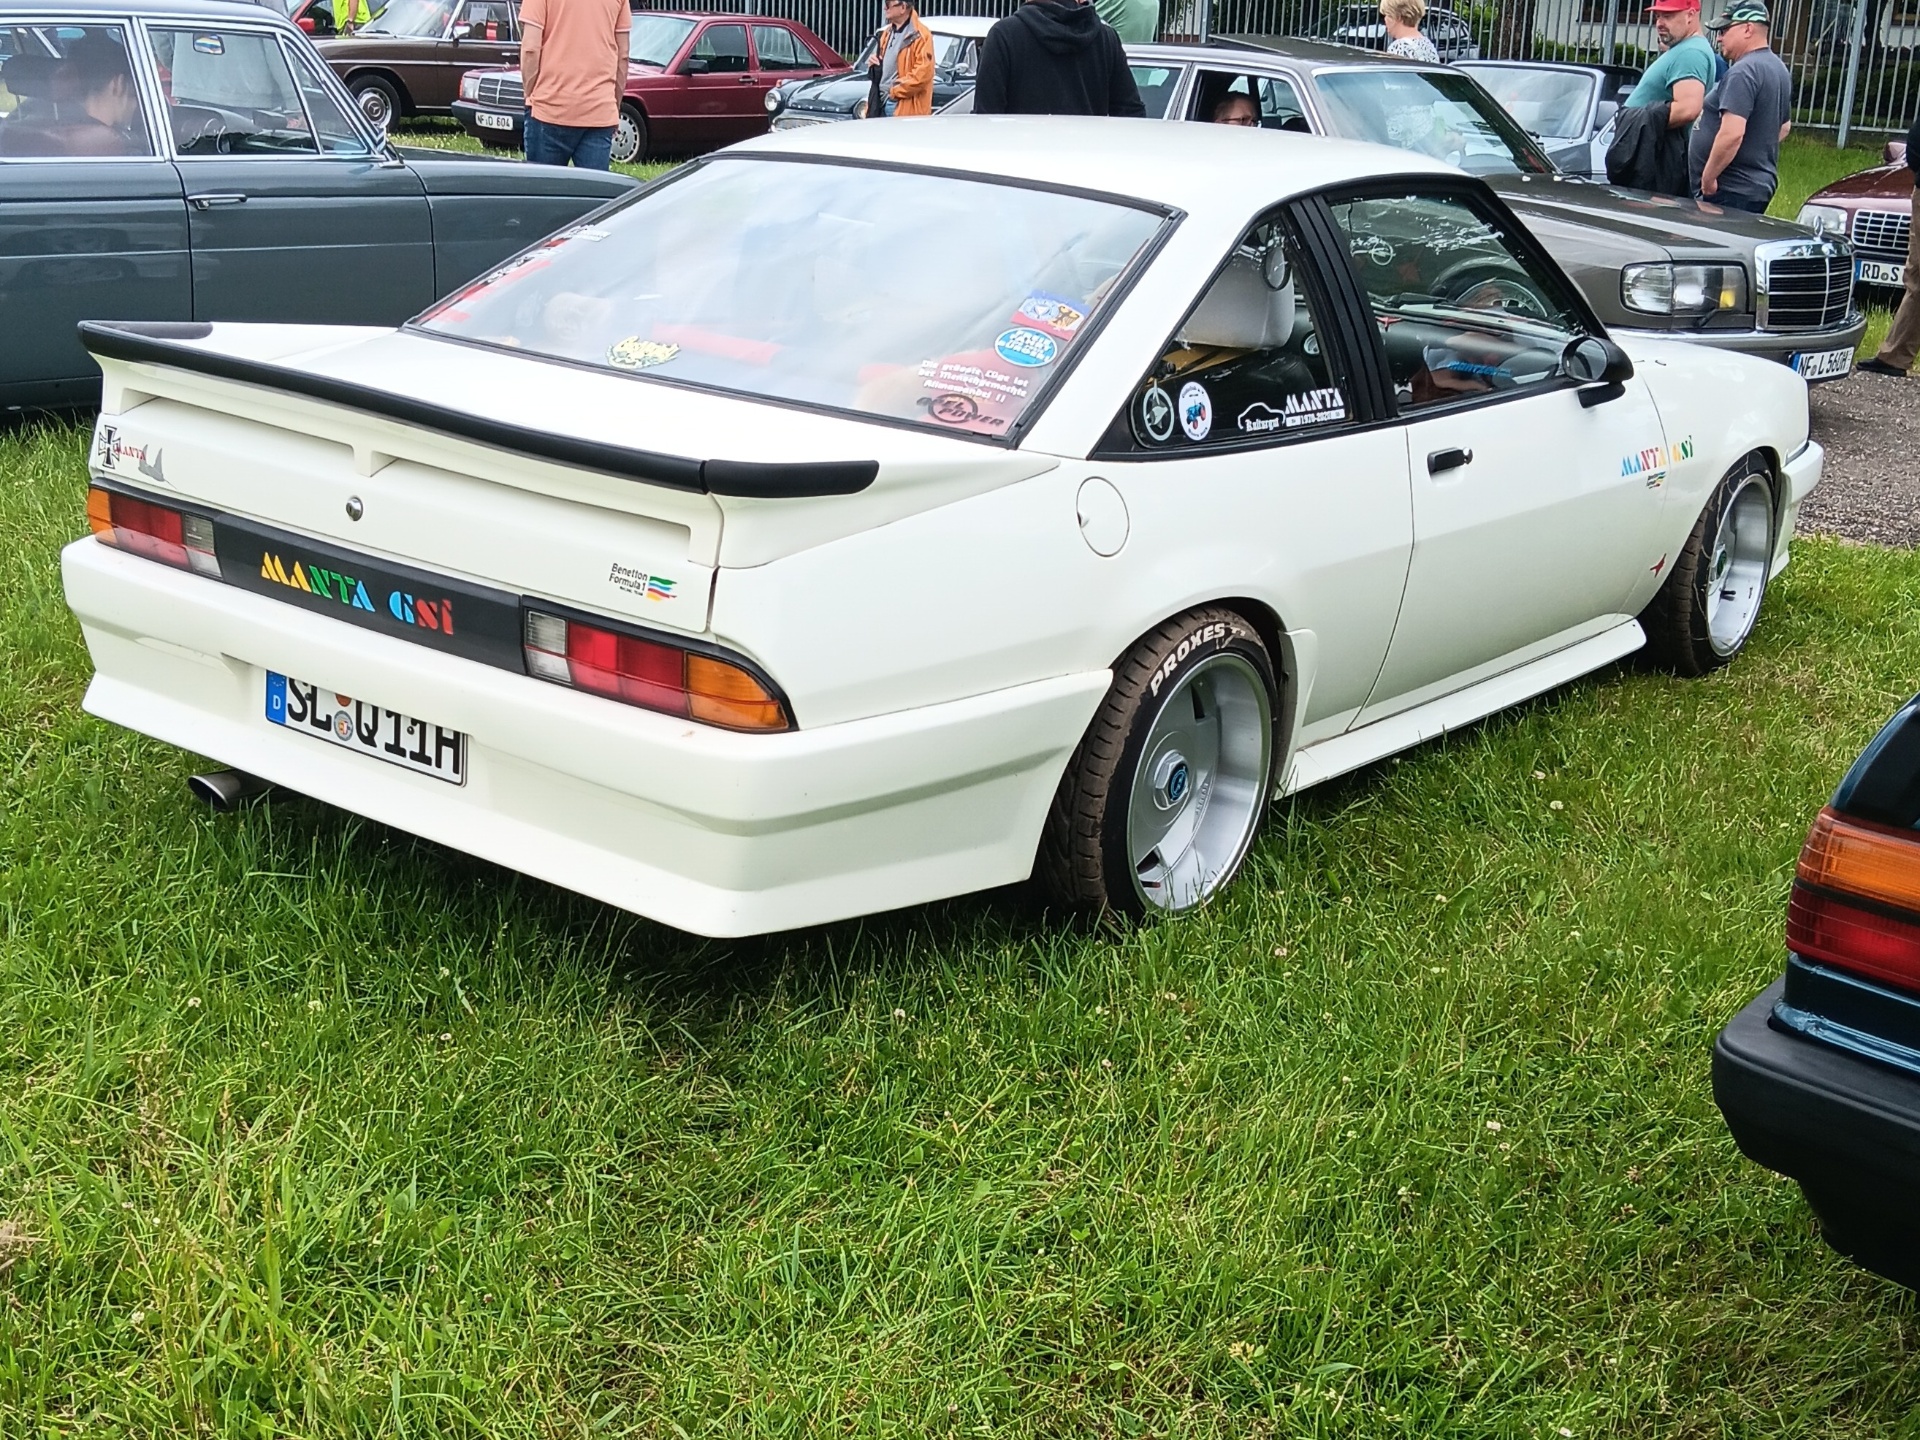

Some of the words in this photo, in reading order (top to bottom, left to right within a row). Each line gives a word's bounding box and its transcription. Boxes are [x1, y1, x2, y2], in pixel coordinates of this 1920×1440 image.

[496, 116, 510, 127] 604
[1861, 263, 1880, 280] RD
[1890, 266, 1900, 282] S
[921, 359, 938, 370] Die
[985, 369, 1010, 383] Lüge
[1013, 376, 1029, 388] ist
[1797, 355, 1814, 377] NF
[1817, 354, 1825, 375] L
[923, 379, 991, 399] Klimawandel
[939, 370, 1028, 398] Menschgemachte
[1285, 387, 1344, 415] MANTA
[937, 407, 1005, 427] POWER
[1244, 417, 1280, 433] Kulturgut
[1621, 446, 1667, 477] MANTA
[261, 551, 376, 613] MANTA
[609, 573, 641, 590] Formula
[611, 563, 648, 581] Benetton
[1150, 622, 1225, 697] PROXES
[272, 694, 282, 711] D
[287, 677, 332, 733] SL
[355, 699, 378, 749] Q
[384, 709, 461, 775] 11H
